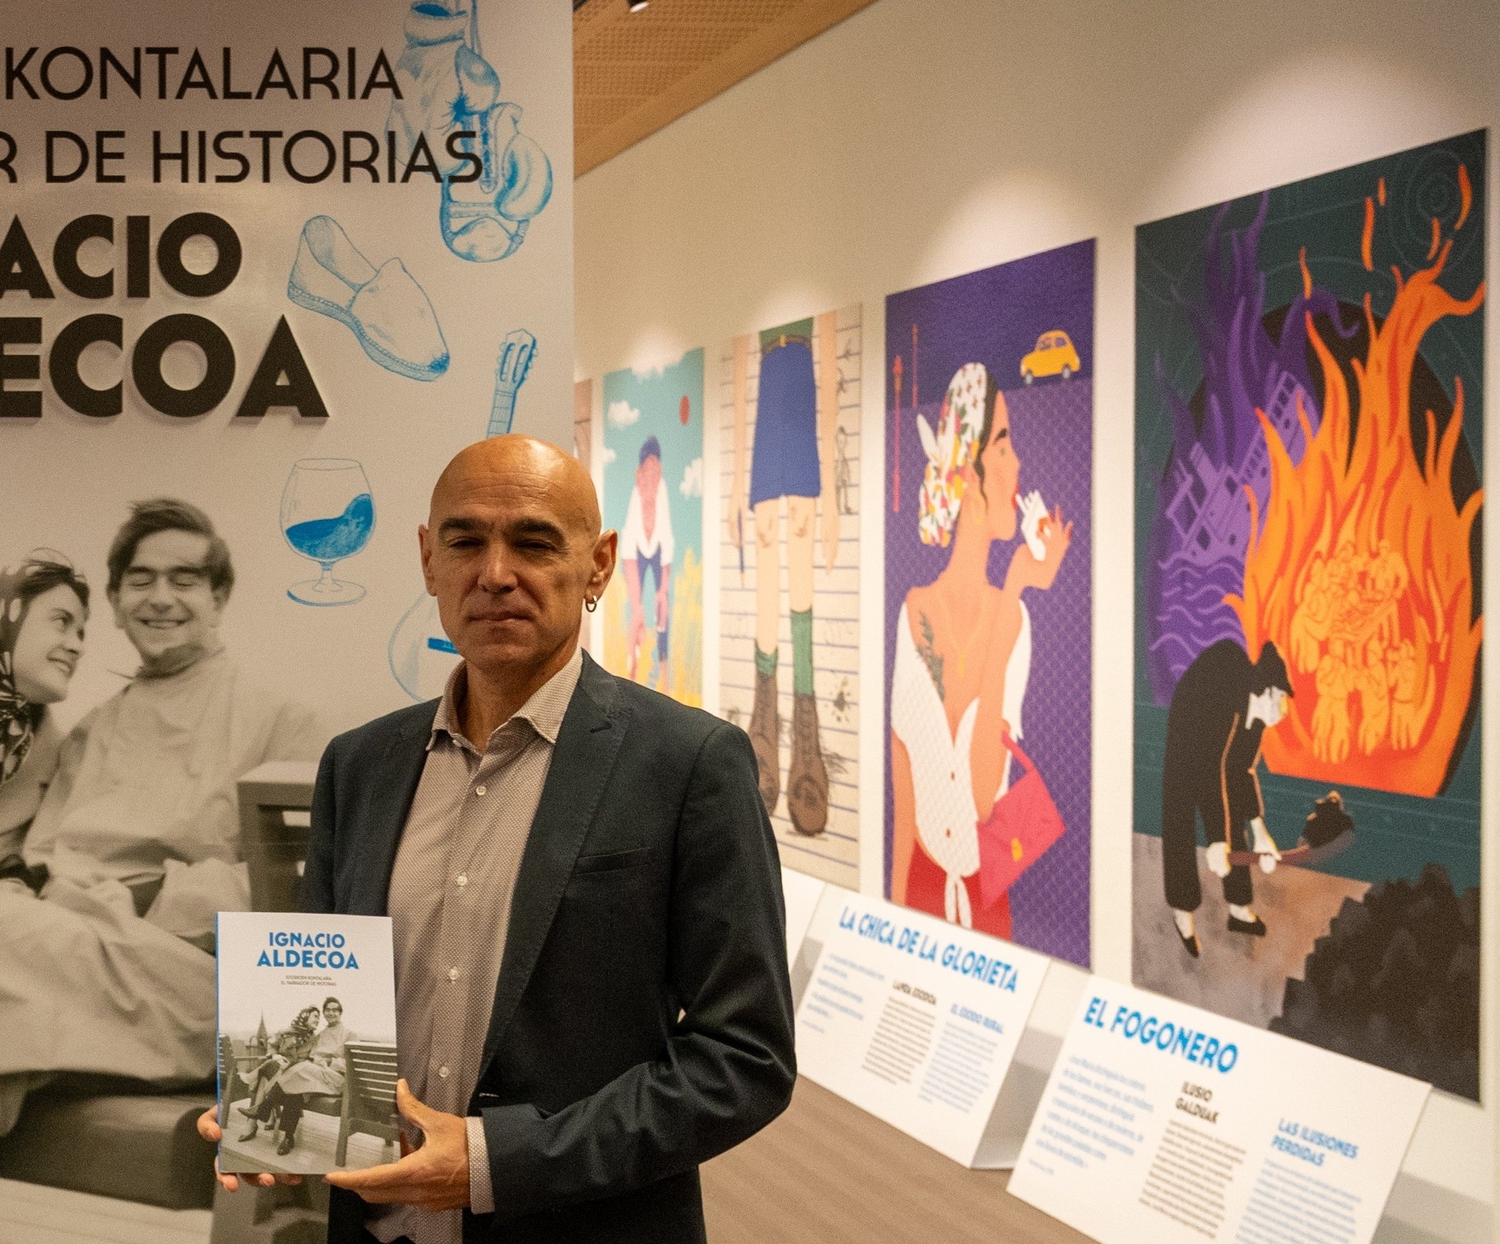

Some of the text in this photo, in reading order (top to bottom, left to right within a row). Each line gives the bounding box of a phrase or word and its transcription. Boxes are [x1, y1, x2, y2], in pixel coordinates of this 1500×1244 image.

[5, 46, 404, 101] KONTALARIA
[45, 130, 125, 184] DE
[152, 129, 483, 184] HISTORIAS
[257, 949, 359, 970] ALDECOA
[268, 932, 346, 949] IGNACIO
[839, 905, 1020, 993] LA CHICA DE LA GLORIETA
[1083, 997, 1239, 1074] EL FOGONERO
[1271, 1134, 1326, 1168] PERDIDAS
[1300, 1126, 1359, 1160] ILUSIONES
